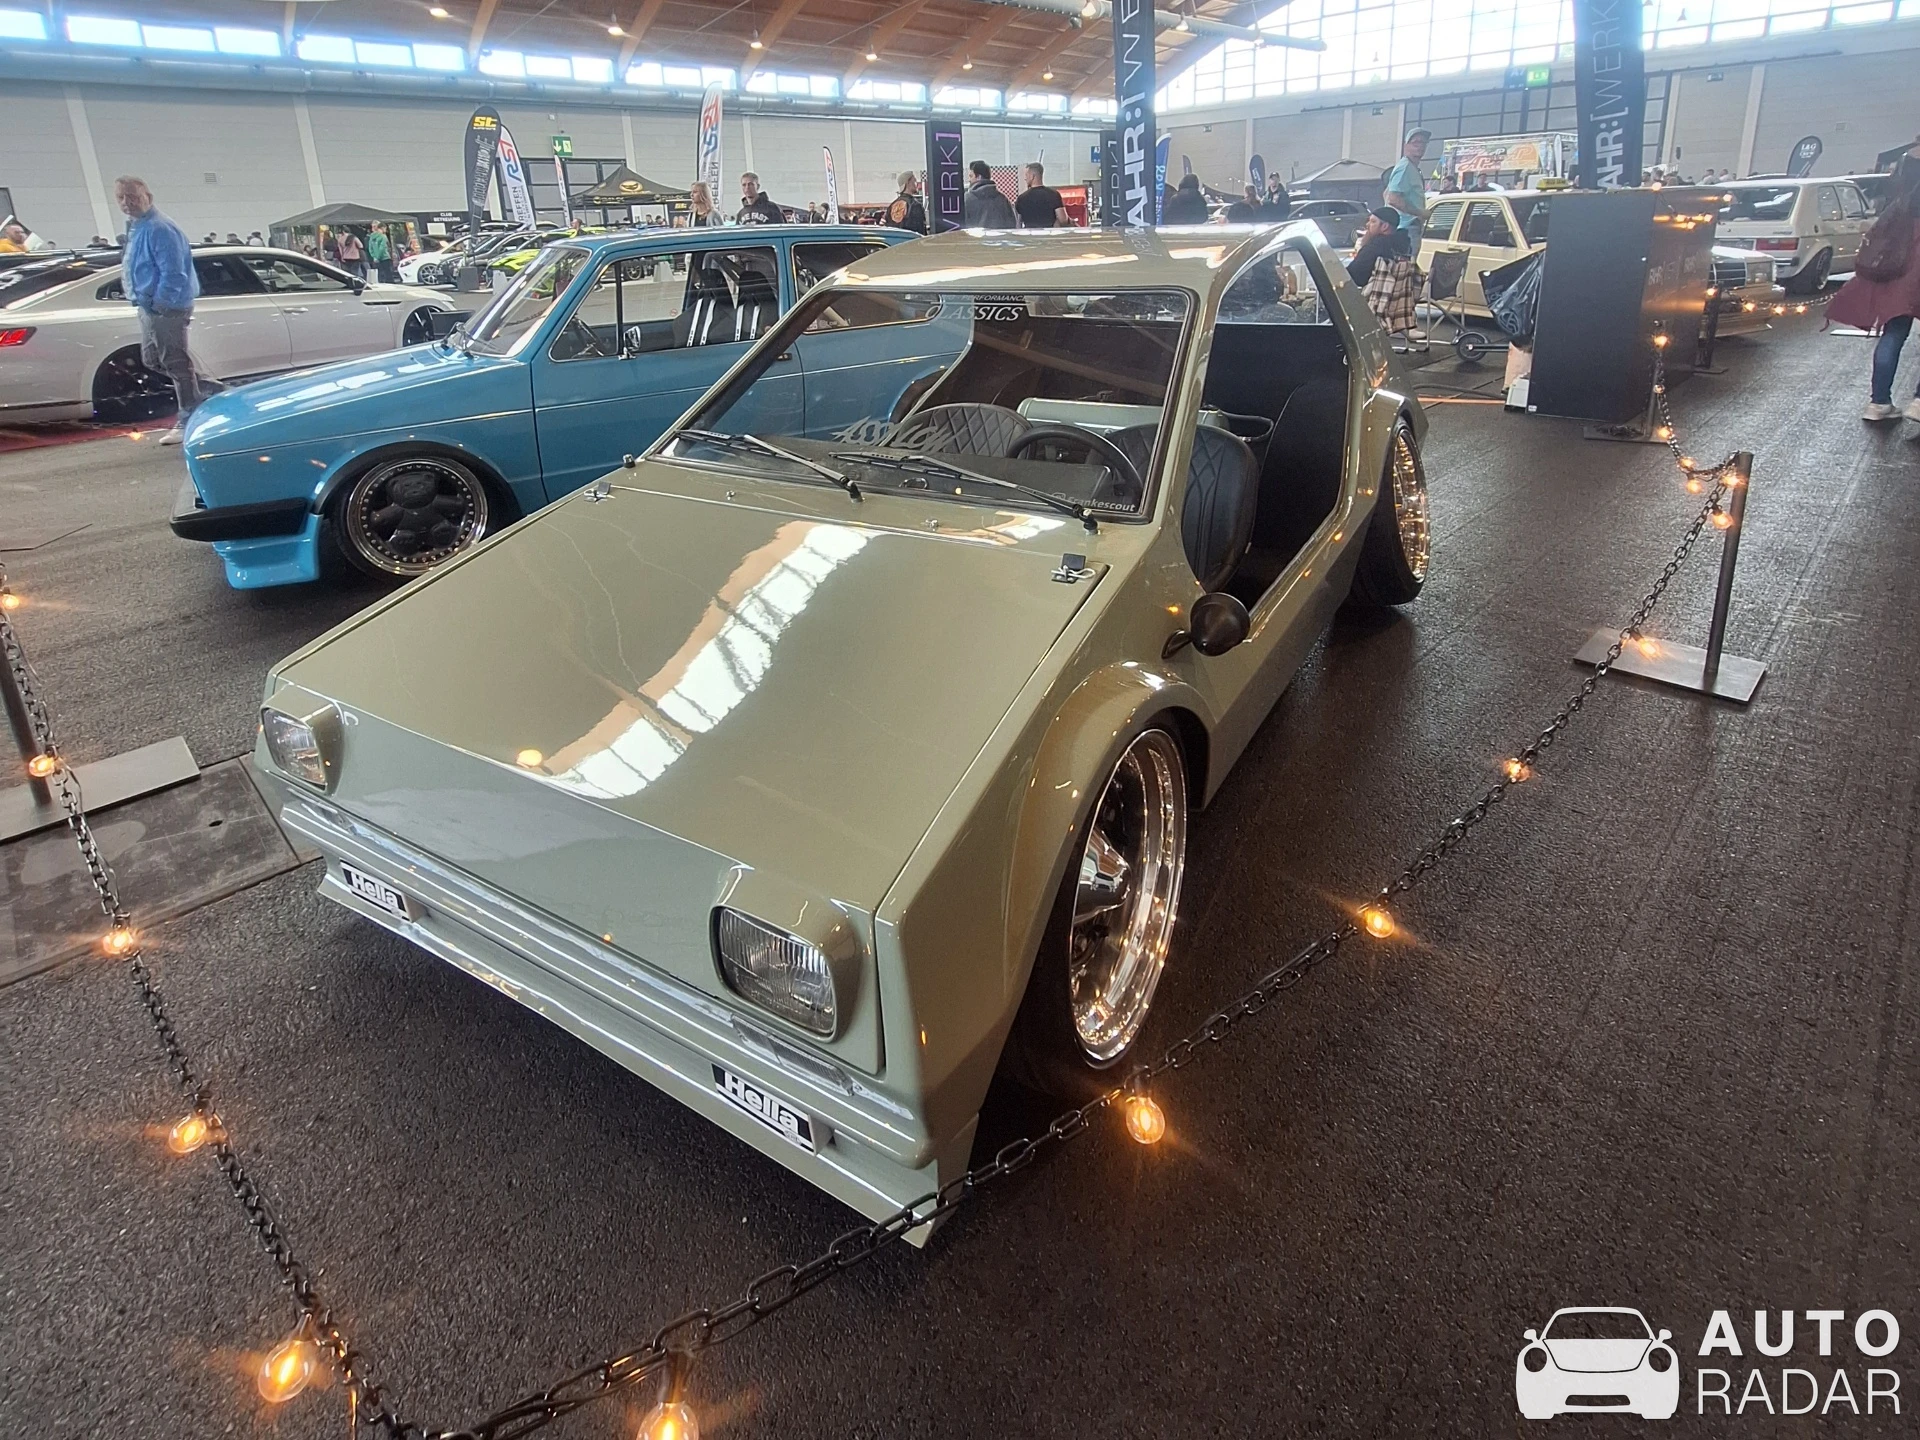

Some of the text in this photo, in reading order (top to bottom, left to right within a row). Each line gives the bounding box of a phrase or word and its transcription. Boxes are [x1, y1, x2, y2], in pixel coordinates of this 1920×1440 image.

[925, 305, 1024, 321] CLASSICS
[350, 871, 400, 909] Hella
[724, 1070, 799, 1135] Hella
